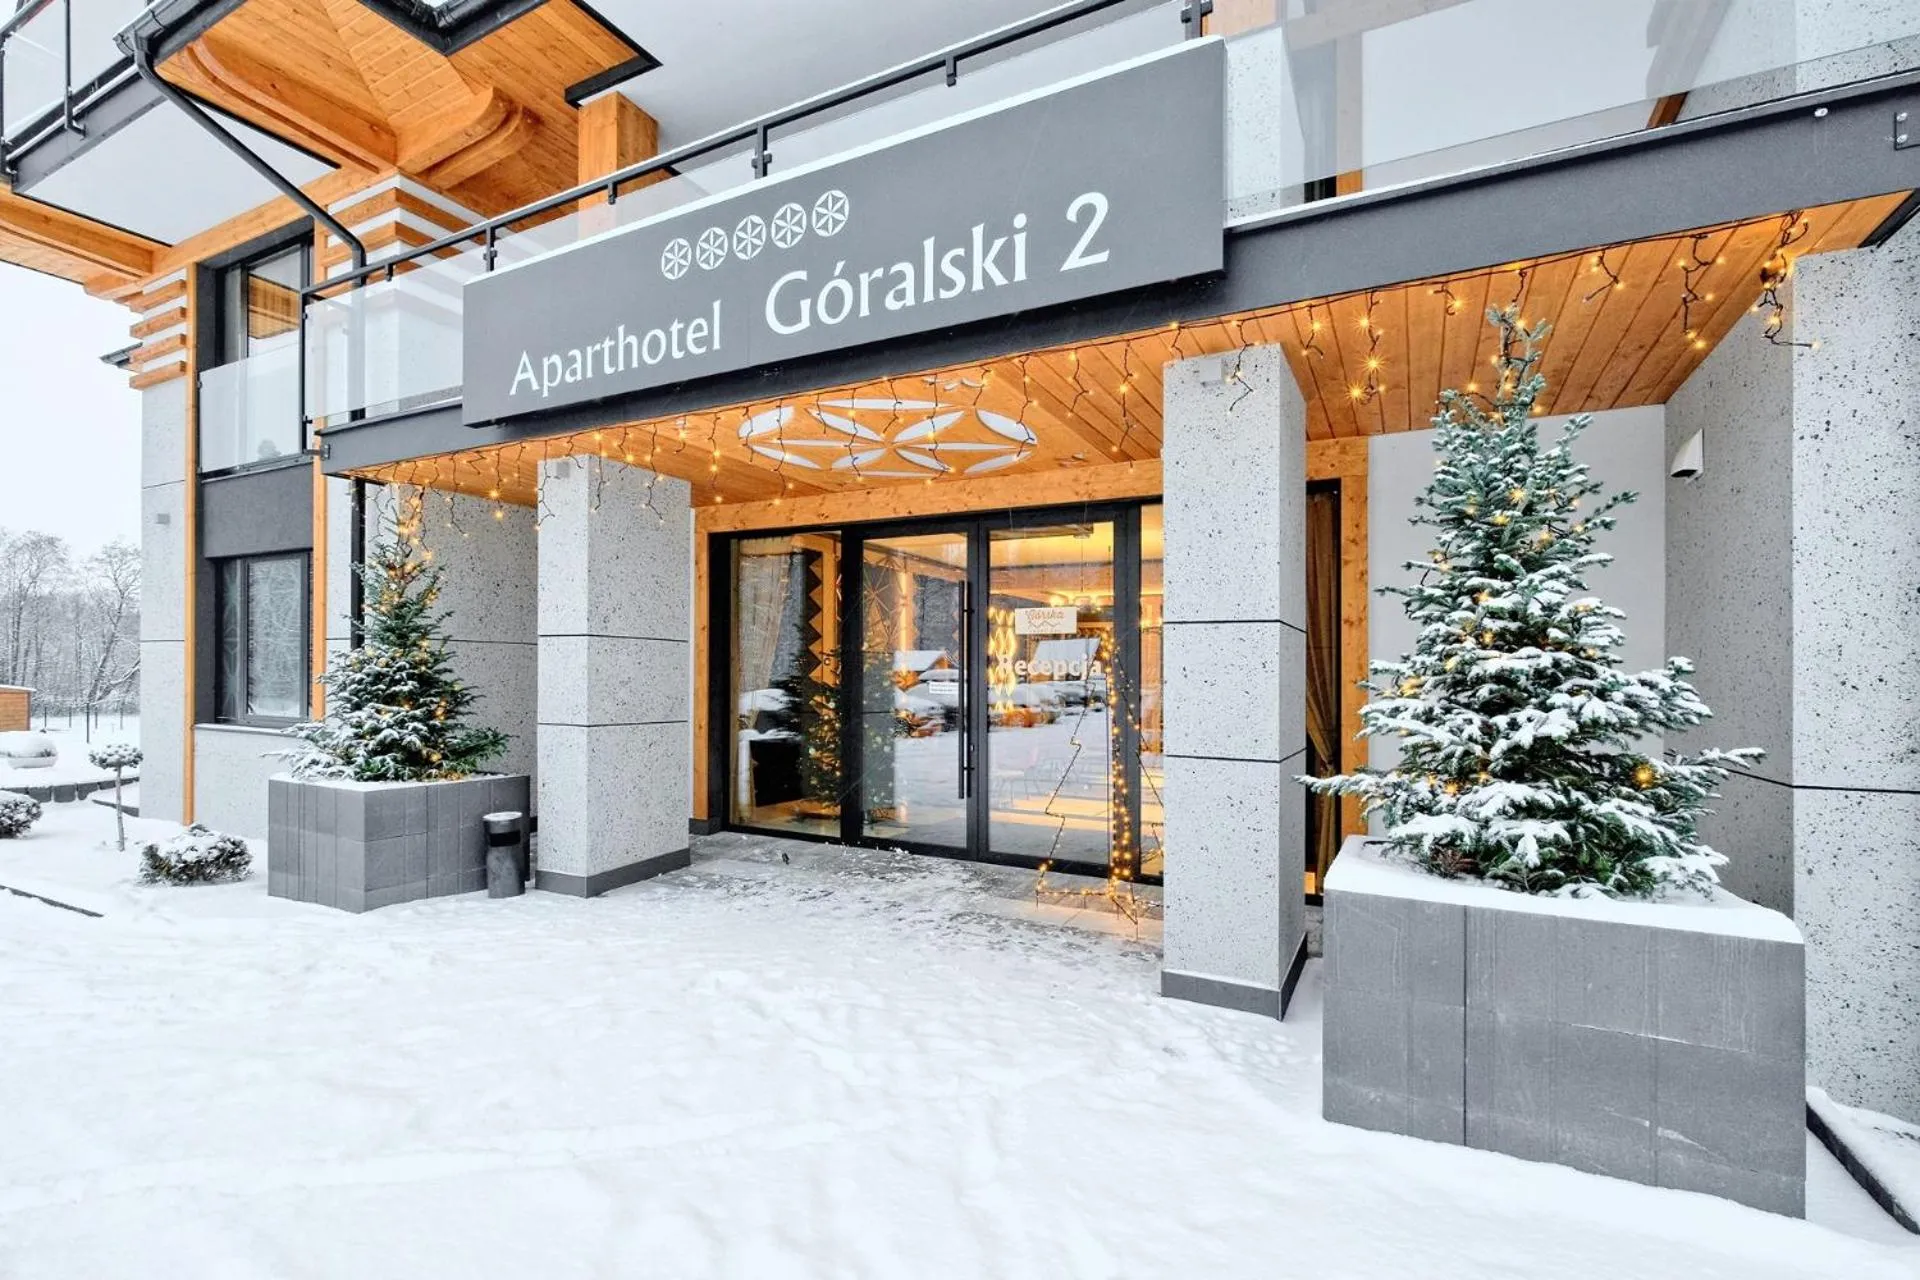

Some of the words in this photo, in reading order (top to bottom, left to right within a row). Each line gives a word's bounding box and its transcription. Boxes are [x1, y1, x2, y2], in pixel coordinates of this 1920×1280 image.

[509, 300, 721, 398] Aparthotel
[765, 213, 1028, 335] Góralski
[1059, 191, 1110, 272] 2
